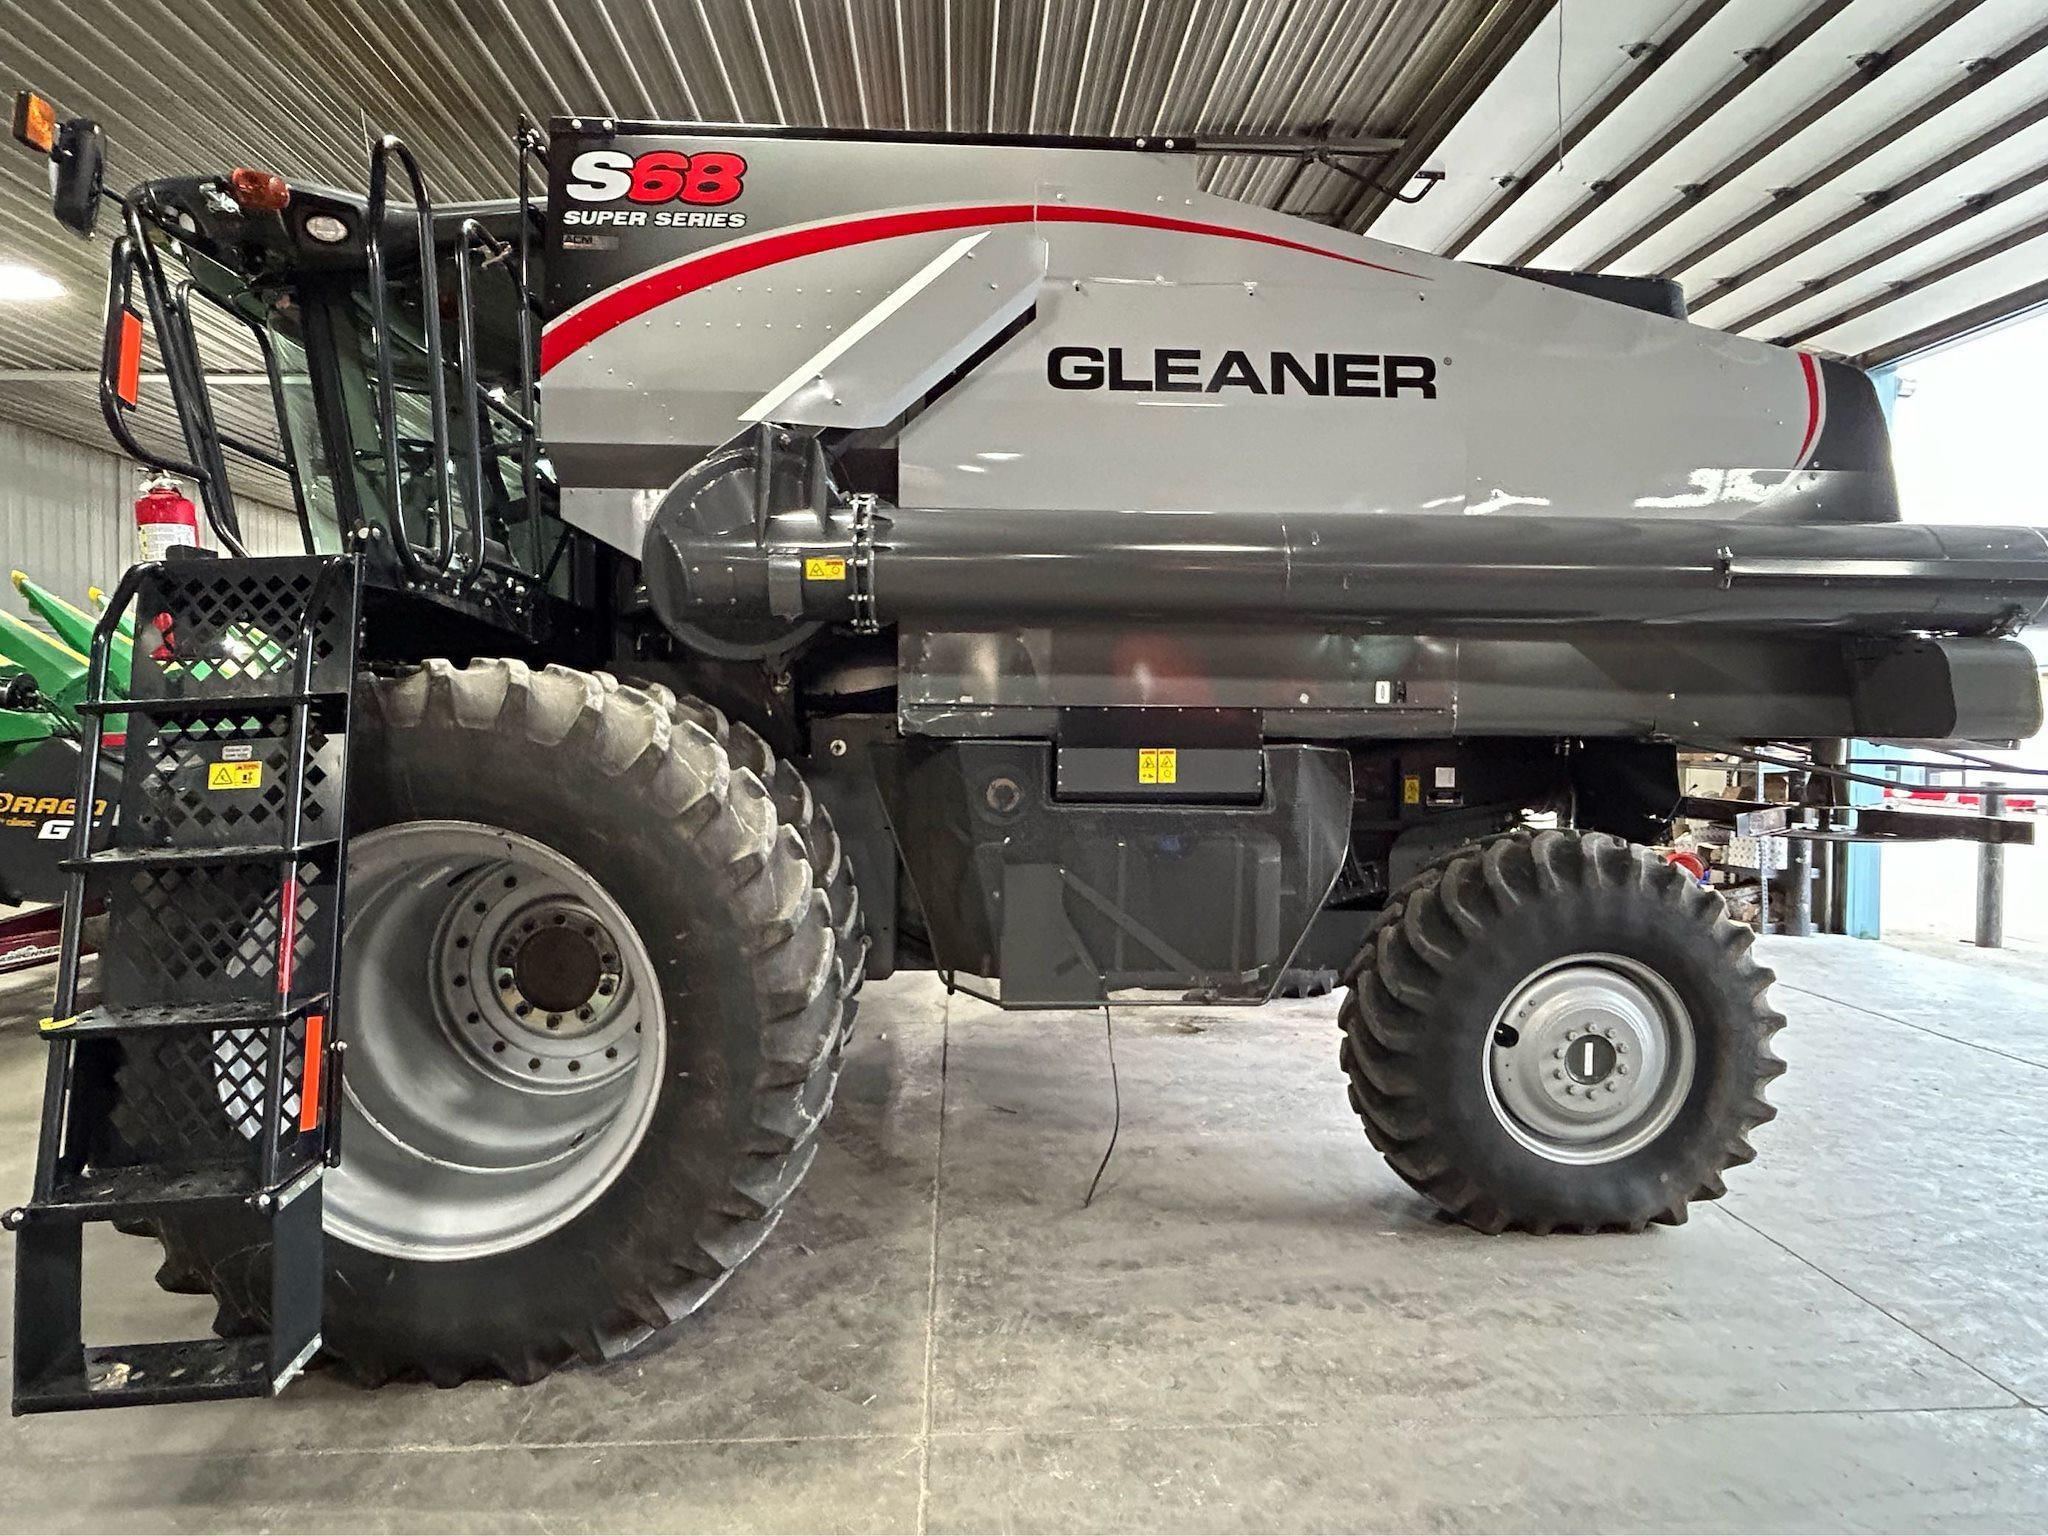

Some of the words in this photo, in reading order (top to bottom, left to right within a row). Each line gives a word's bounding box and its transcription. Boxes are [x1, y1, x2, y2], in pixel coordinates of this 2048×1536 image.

[566, 150, 748, 206] S68
[563, 210, 648, 226] SUPER
[654, 212, 747, 228] SERIES
[1047, 346, 1437, 399] GLEANER
